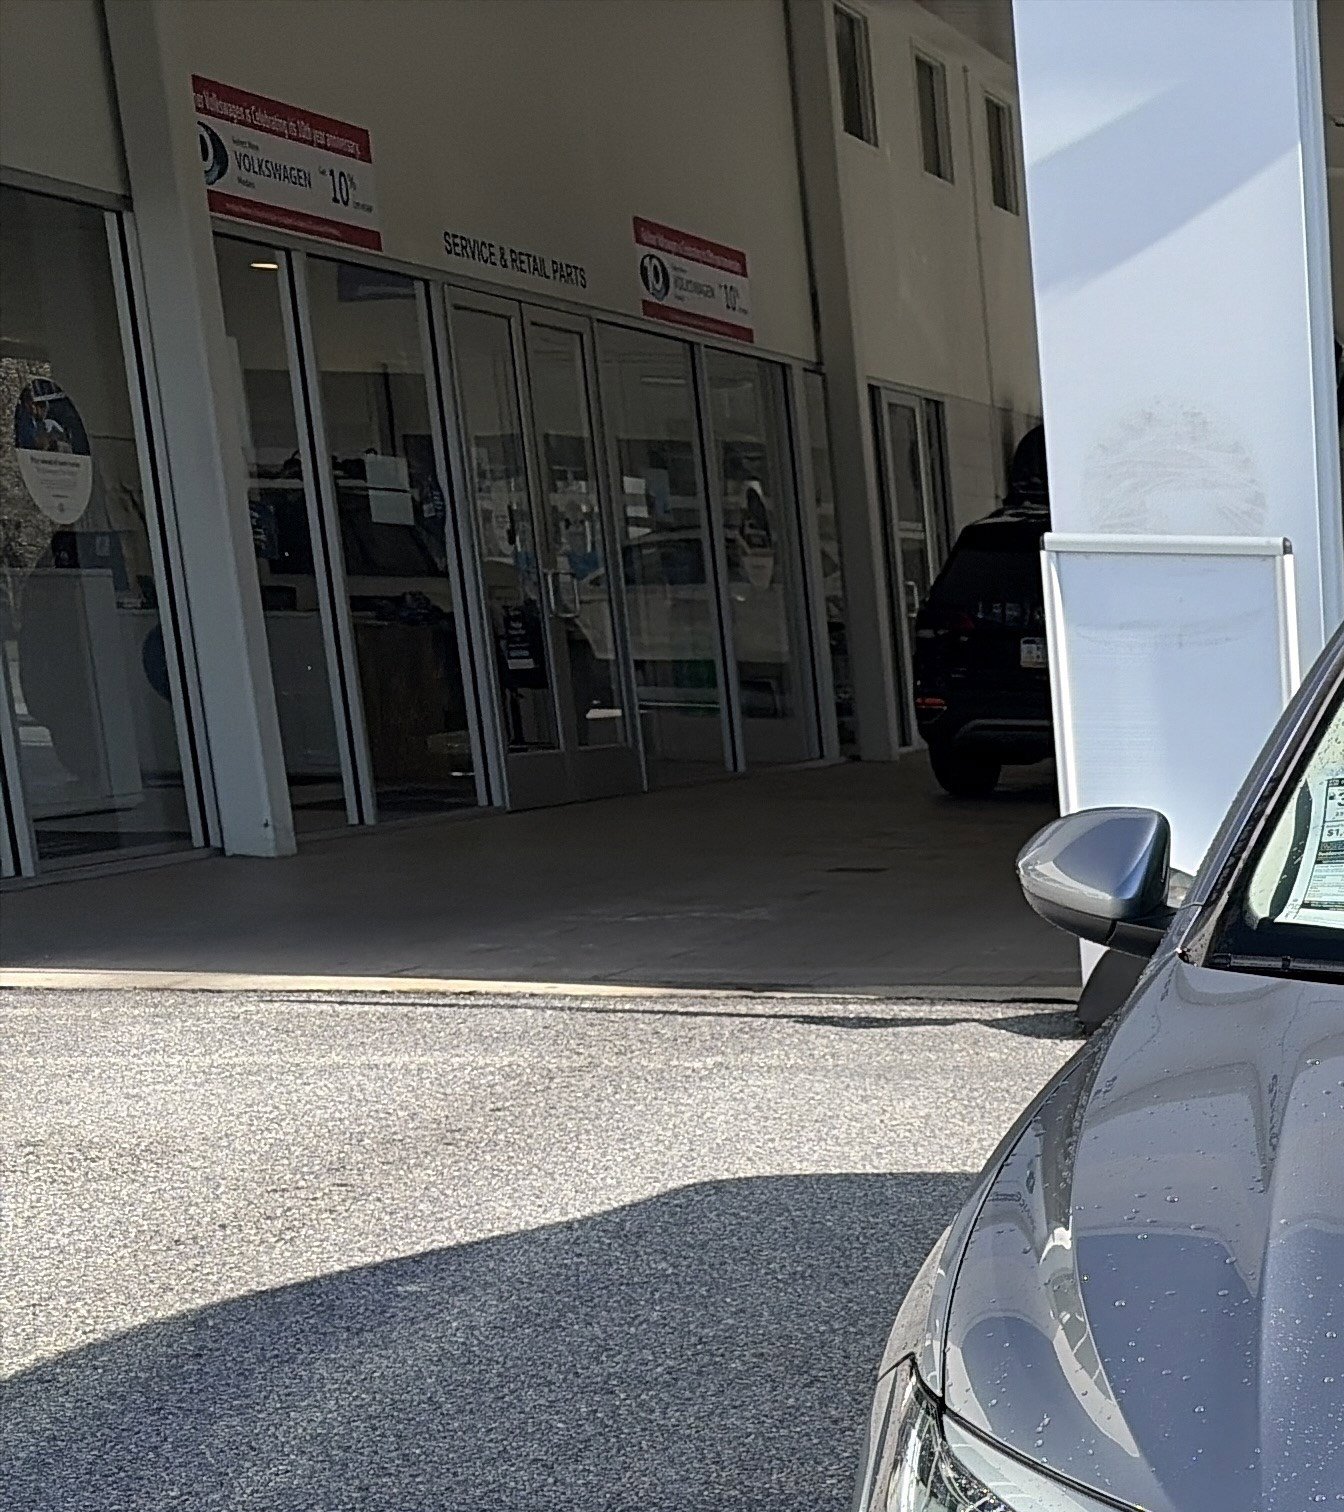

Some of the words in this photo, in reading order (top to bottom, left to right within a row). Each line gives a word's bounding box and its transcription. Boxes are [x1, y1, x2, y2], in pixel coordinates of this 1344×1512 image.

[234, 150, 312, 188] VOLKSWAGEN
[443, 231, 497, 266] SERVICE
[499, 246, 508, 268] &
[509, 248, 550, 279] RETAIL
[551, 259, 587, 288] PARTS
